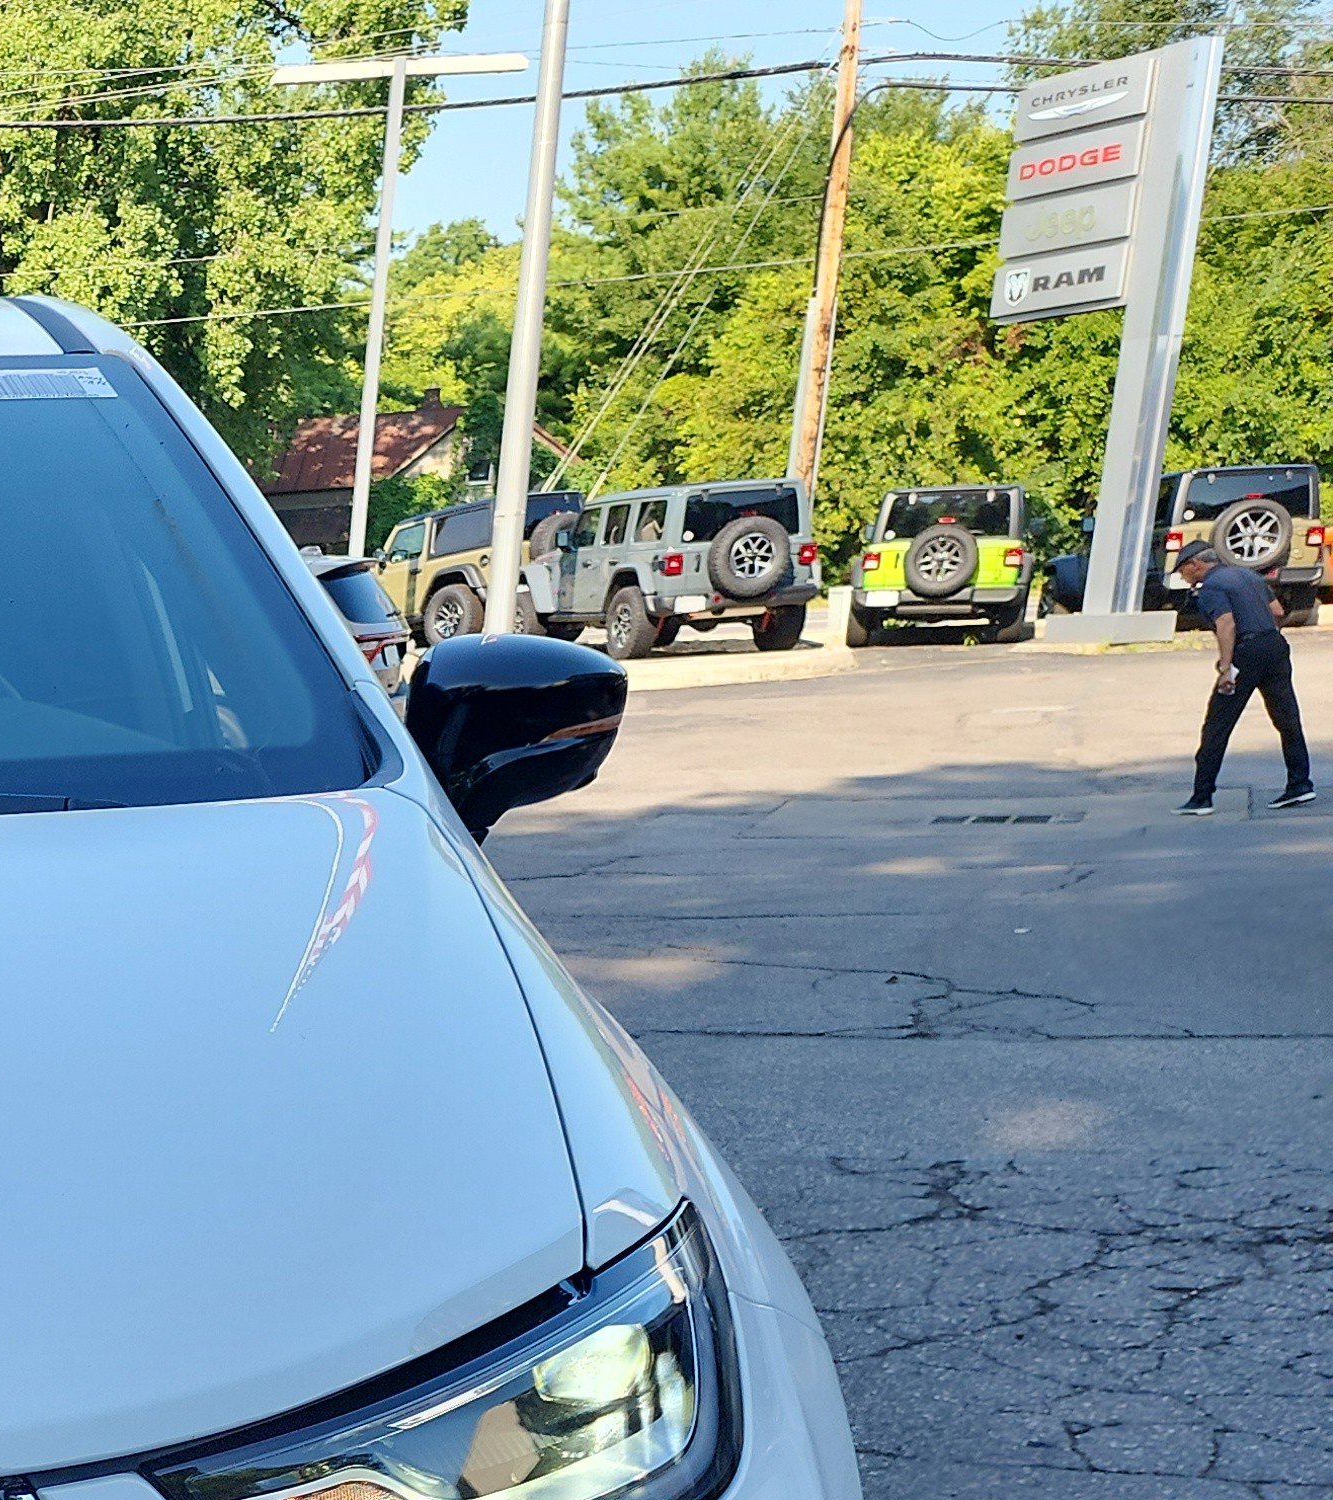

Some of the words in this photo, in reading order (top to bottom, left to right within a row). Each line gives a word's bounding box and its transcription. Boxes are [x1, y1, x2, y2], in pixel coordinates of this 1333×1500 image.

[1031, 75, 1129, 108] CHRYSLER
[1019, 144, 1121, 180] DODGE
[1025, 204, 1096, 241] Jeep
[1033, 266, 1106, 292] RAM
